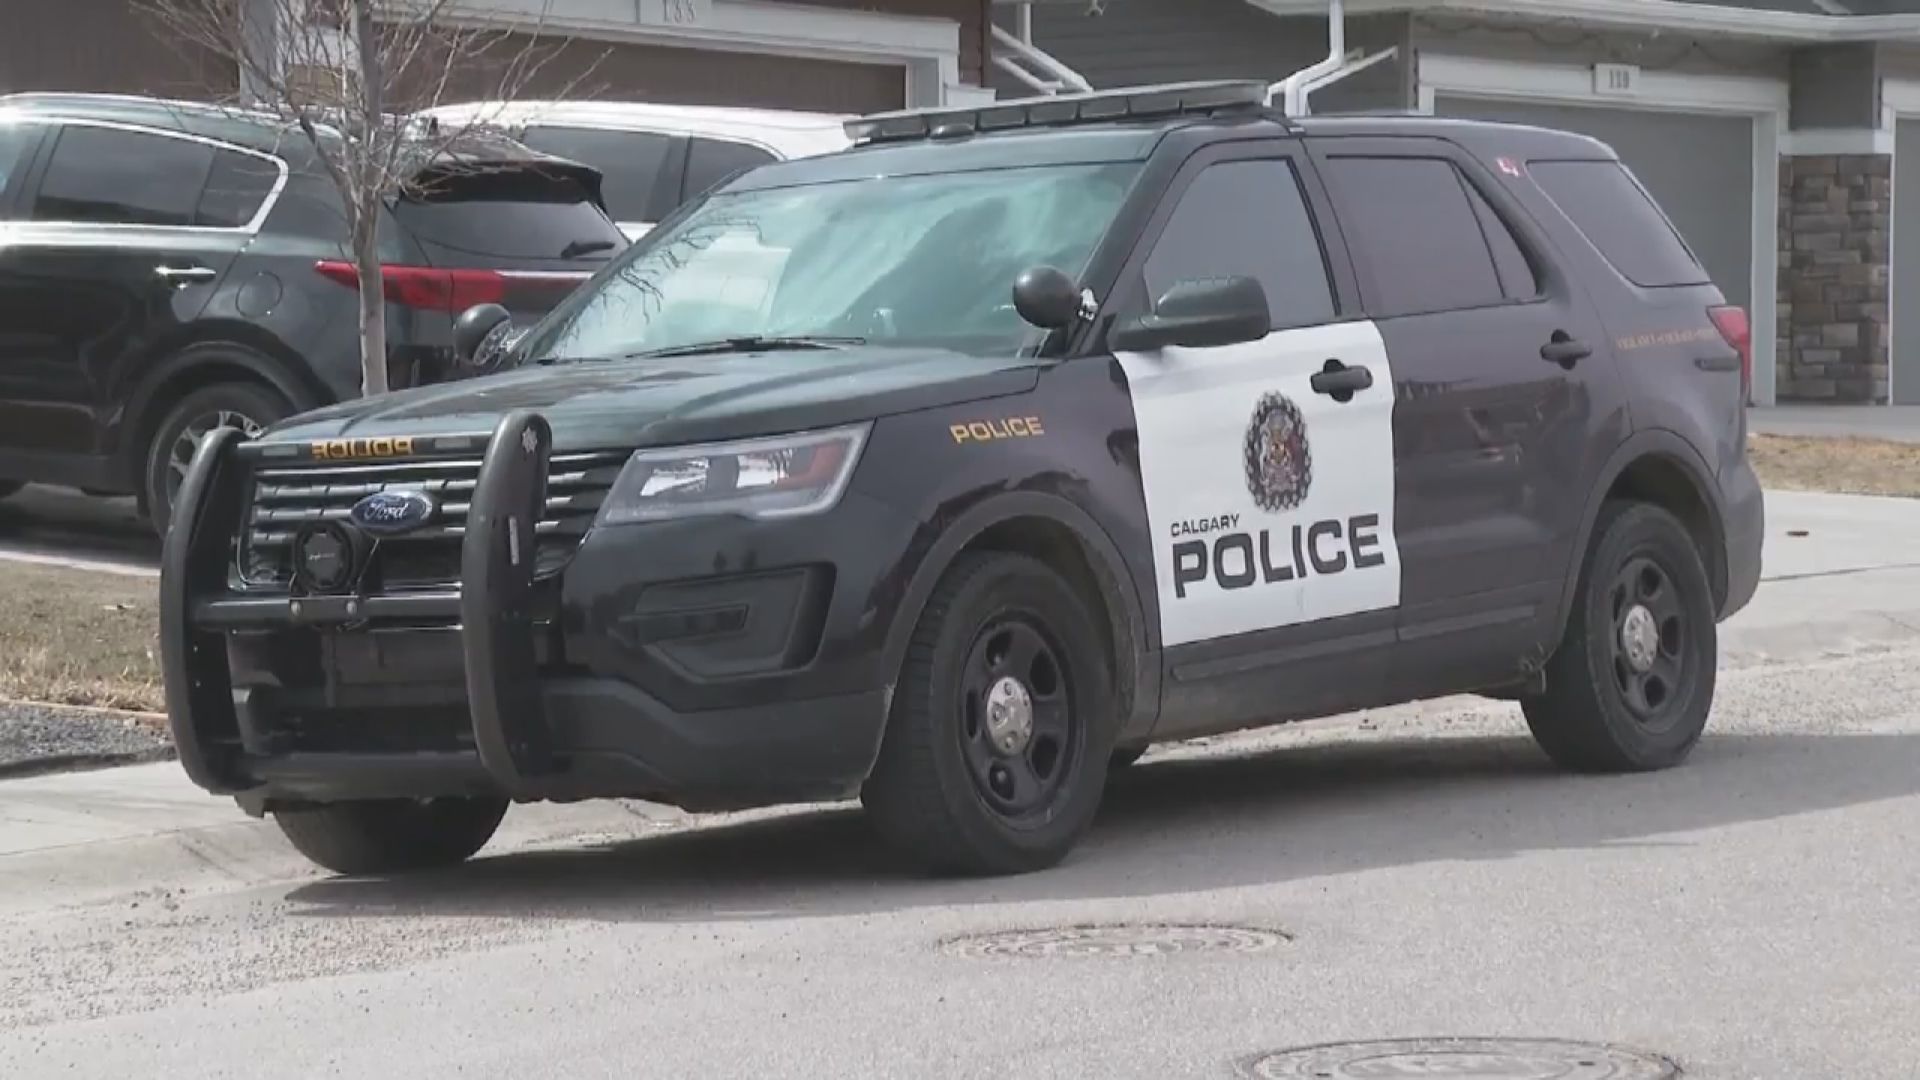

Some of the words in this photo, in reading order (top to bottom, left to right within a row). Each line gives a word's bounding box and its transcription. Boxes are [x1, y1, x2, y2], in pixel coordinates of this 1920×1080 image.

[950, 416, 1045, 444] POLICE
[364, 501, 409, 521] Ford
[1170, 513, 1240, 537] CALGARY
[1172, 513, 1385, 598] POLICE
